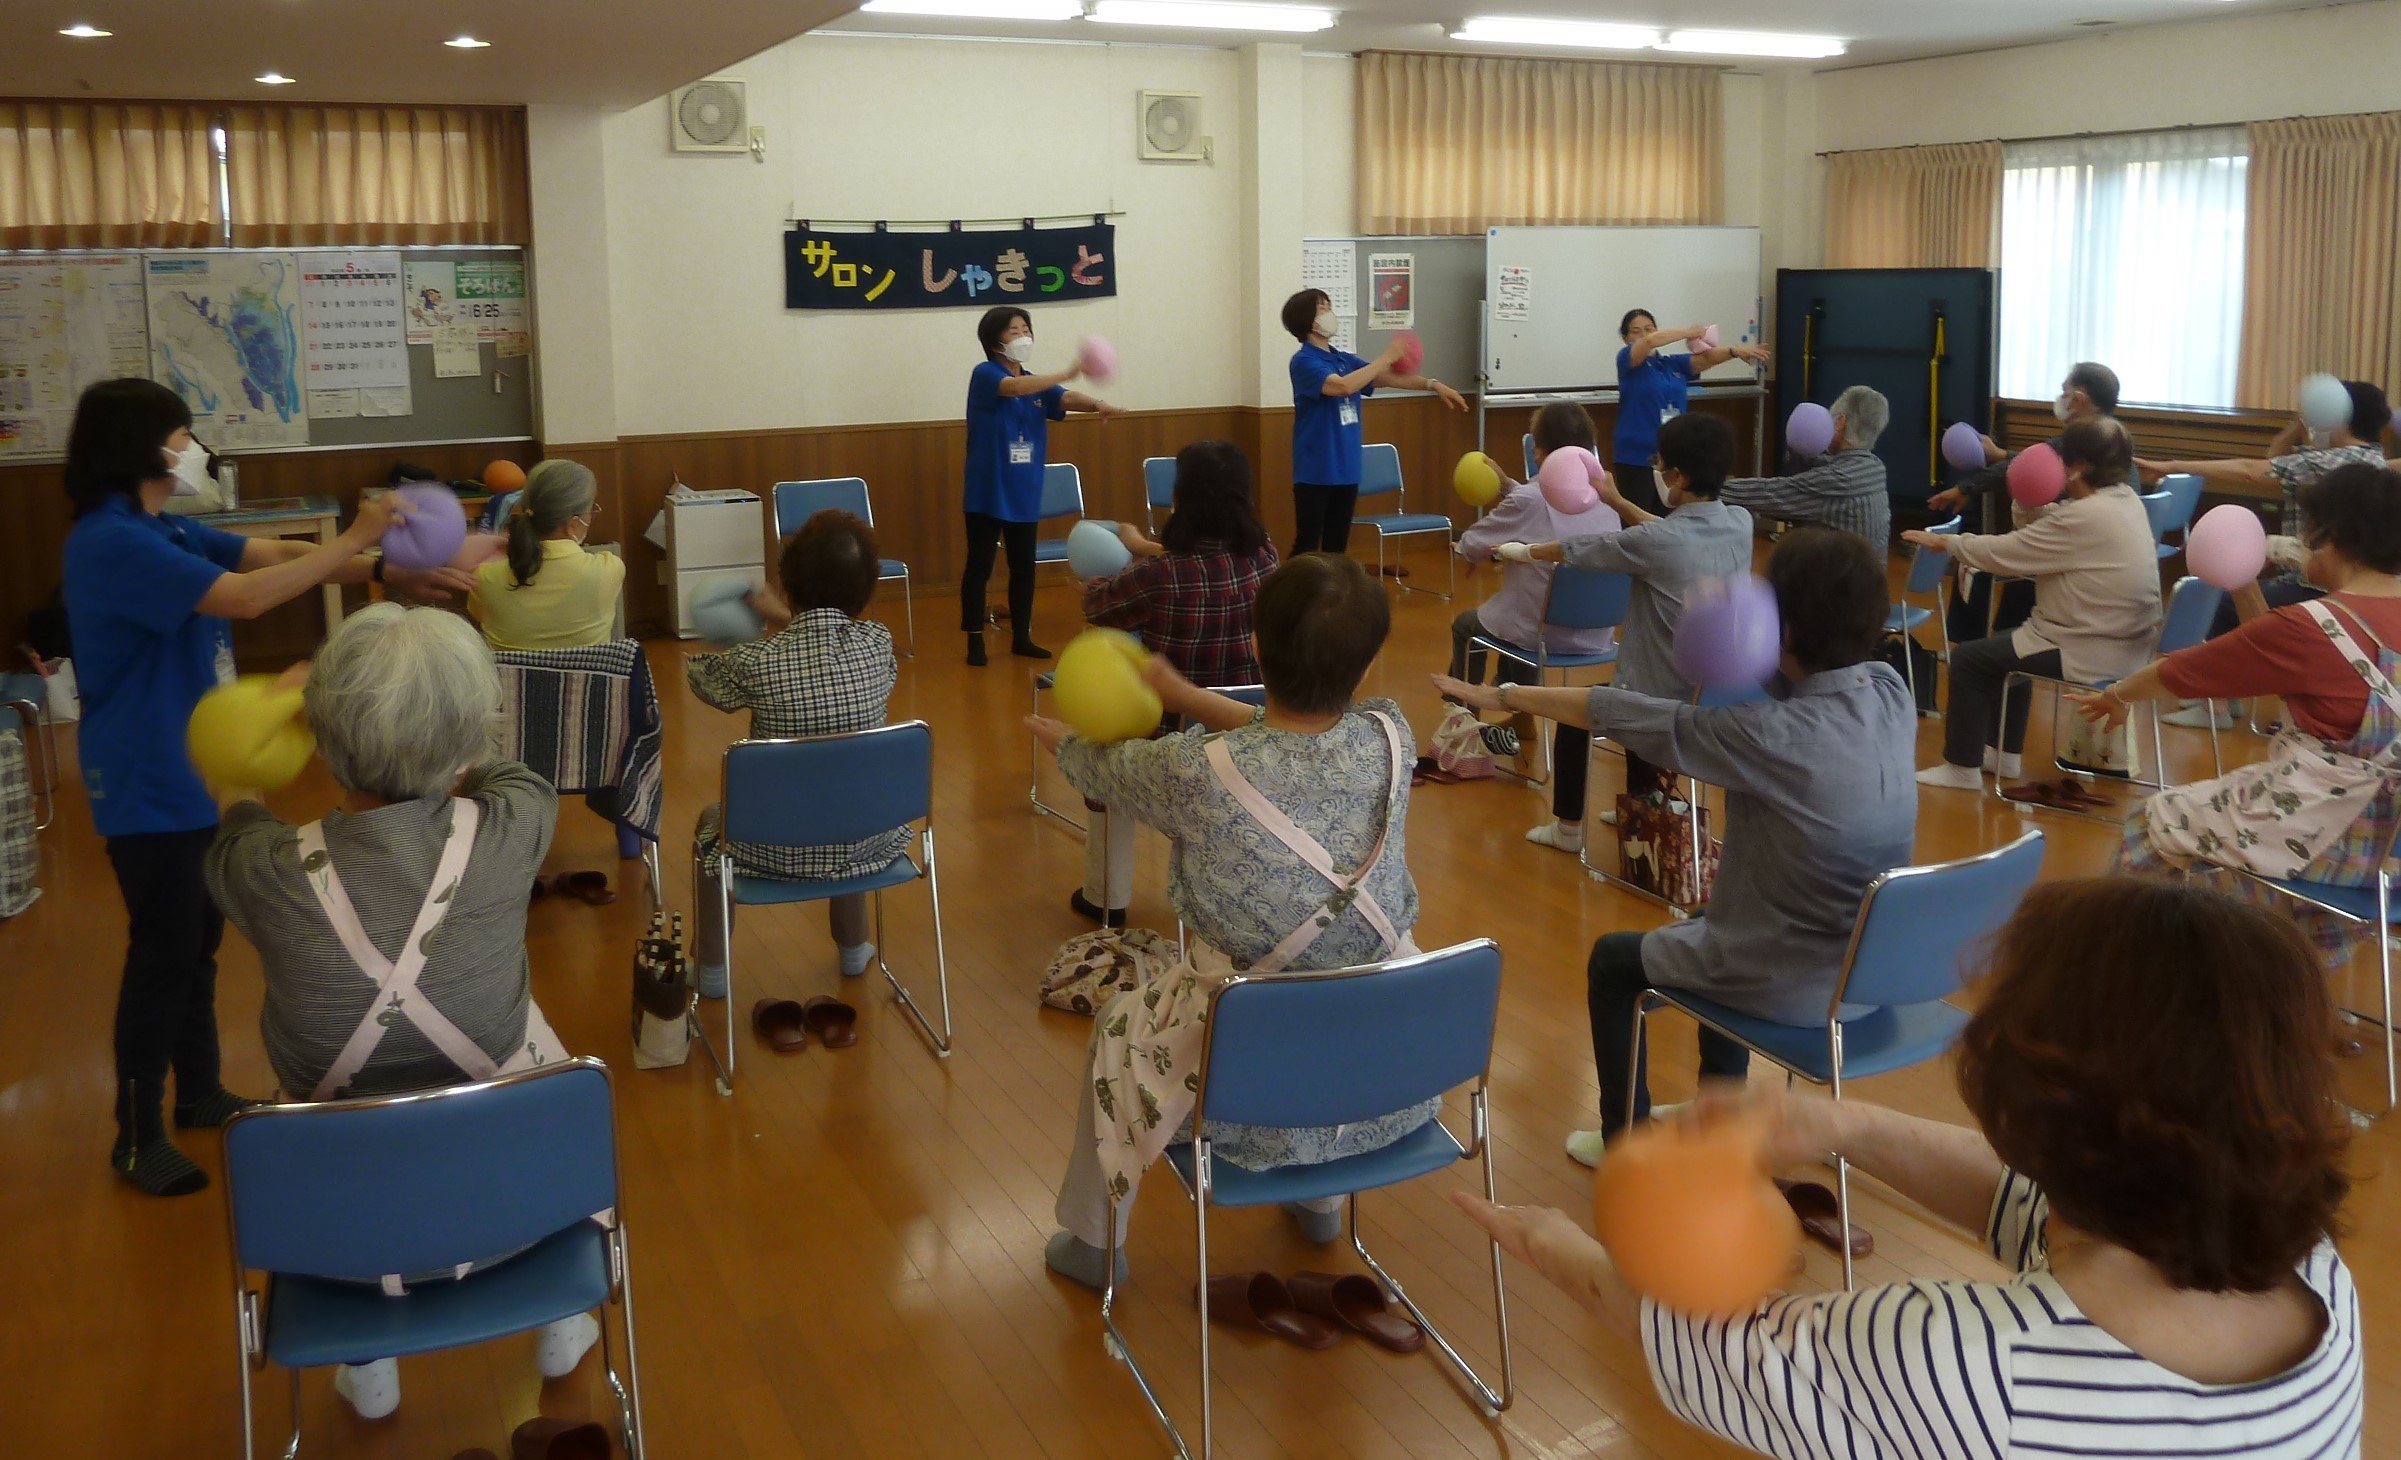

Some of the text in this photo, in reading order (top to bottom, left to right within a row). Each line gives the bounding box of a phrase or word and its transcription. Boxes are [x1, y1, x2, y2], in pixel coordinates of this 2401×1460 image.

[345, 262, 354, 273] 5
[801, 240, 1105, 302] サロン しゃきっと
